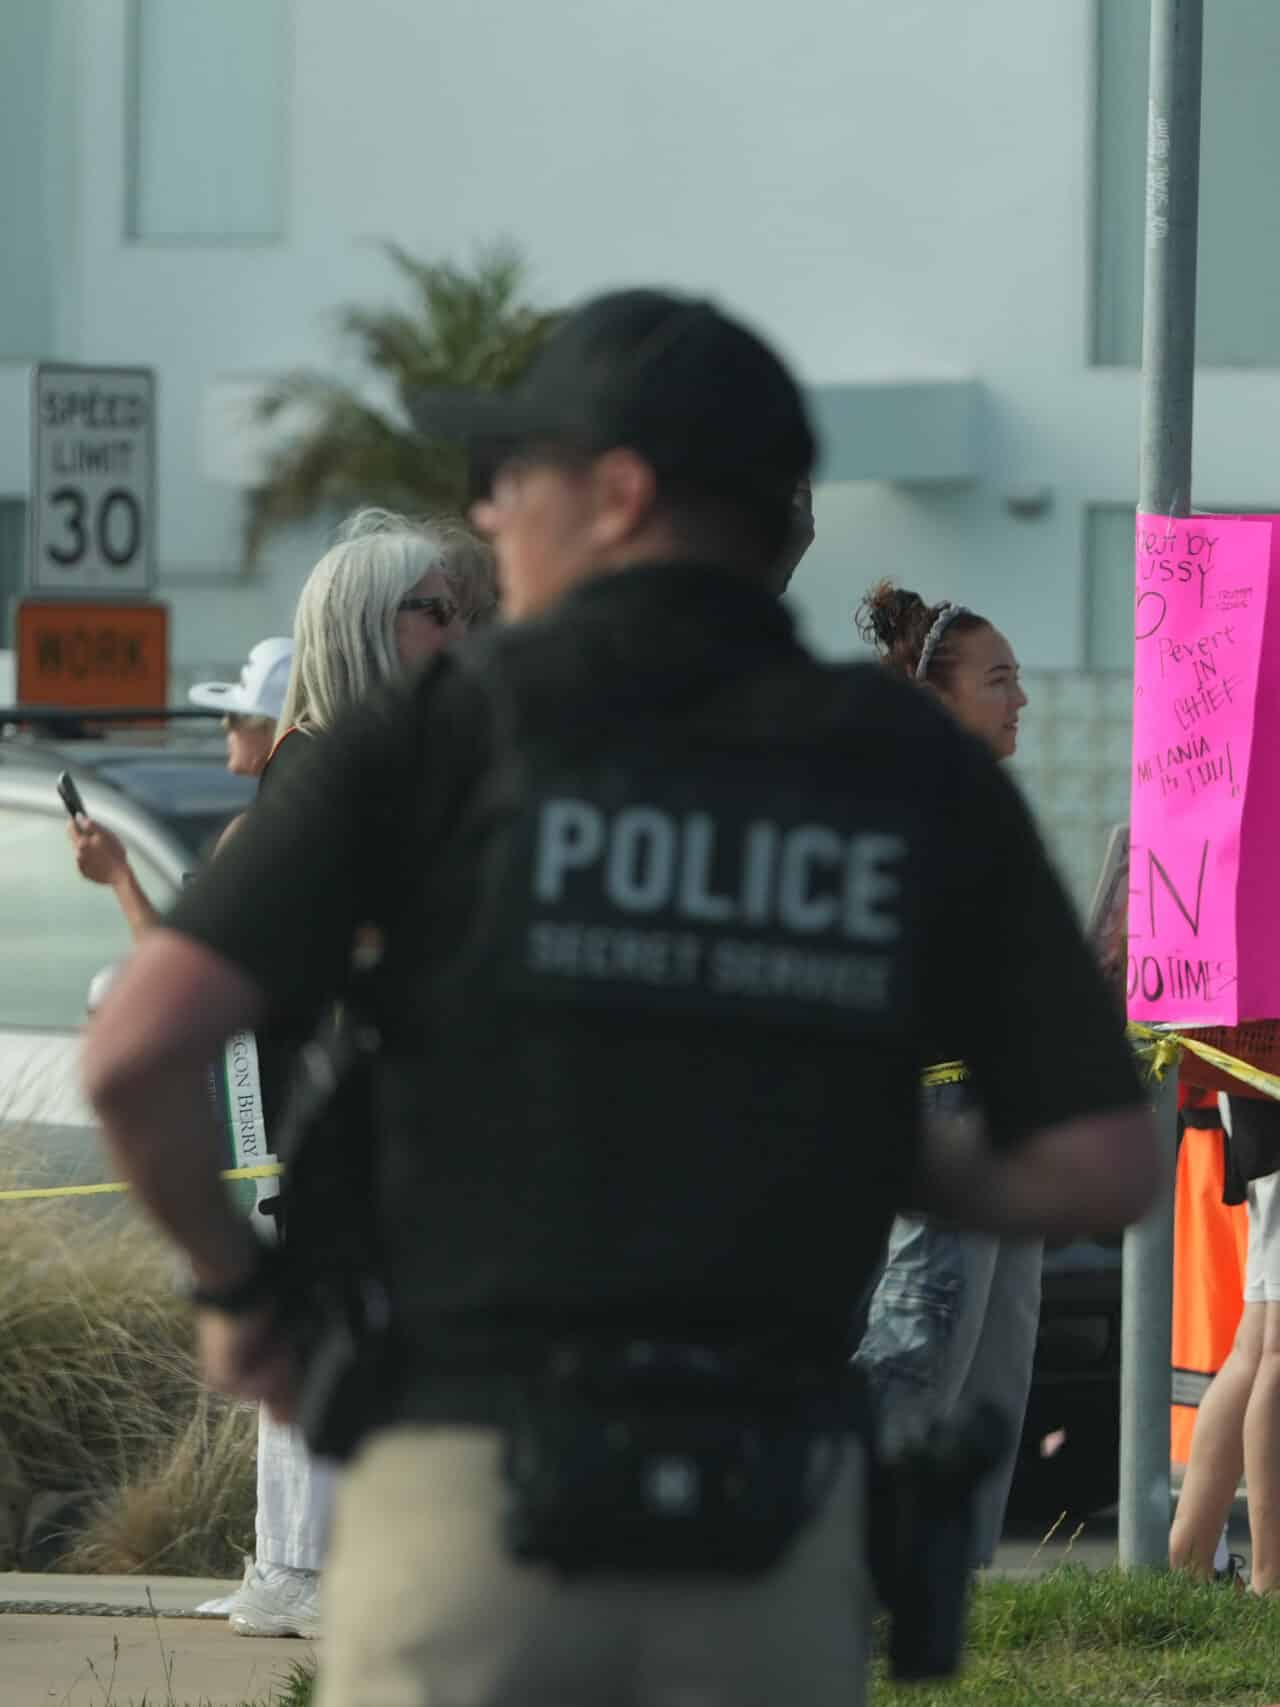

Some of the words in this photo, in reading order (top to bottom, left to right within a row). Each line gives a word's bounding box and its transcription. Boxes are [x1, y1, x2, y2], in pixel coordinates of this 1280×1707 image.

[45, 391, 146, 428] SPEED
[53, 439, 134, 472] LIMIT
[45, 485, 141, 567] 30
[34, 628, 143, 680] WORK
[535, 797, 906, 942] POLICE
[527, 919, 700, 987] SECRET
[237, 1093, 260, 1158] BERRY
